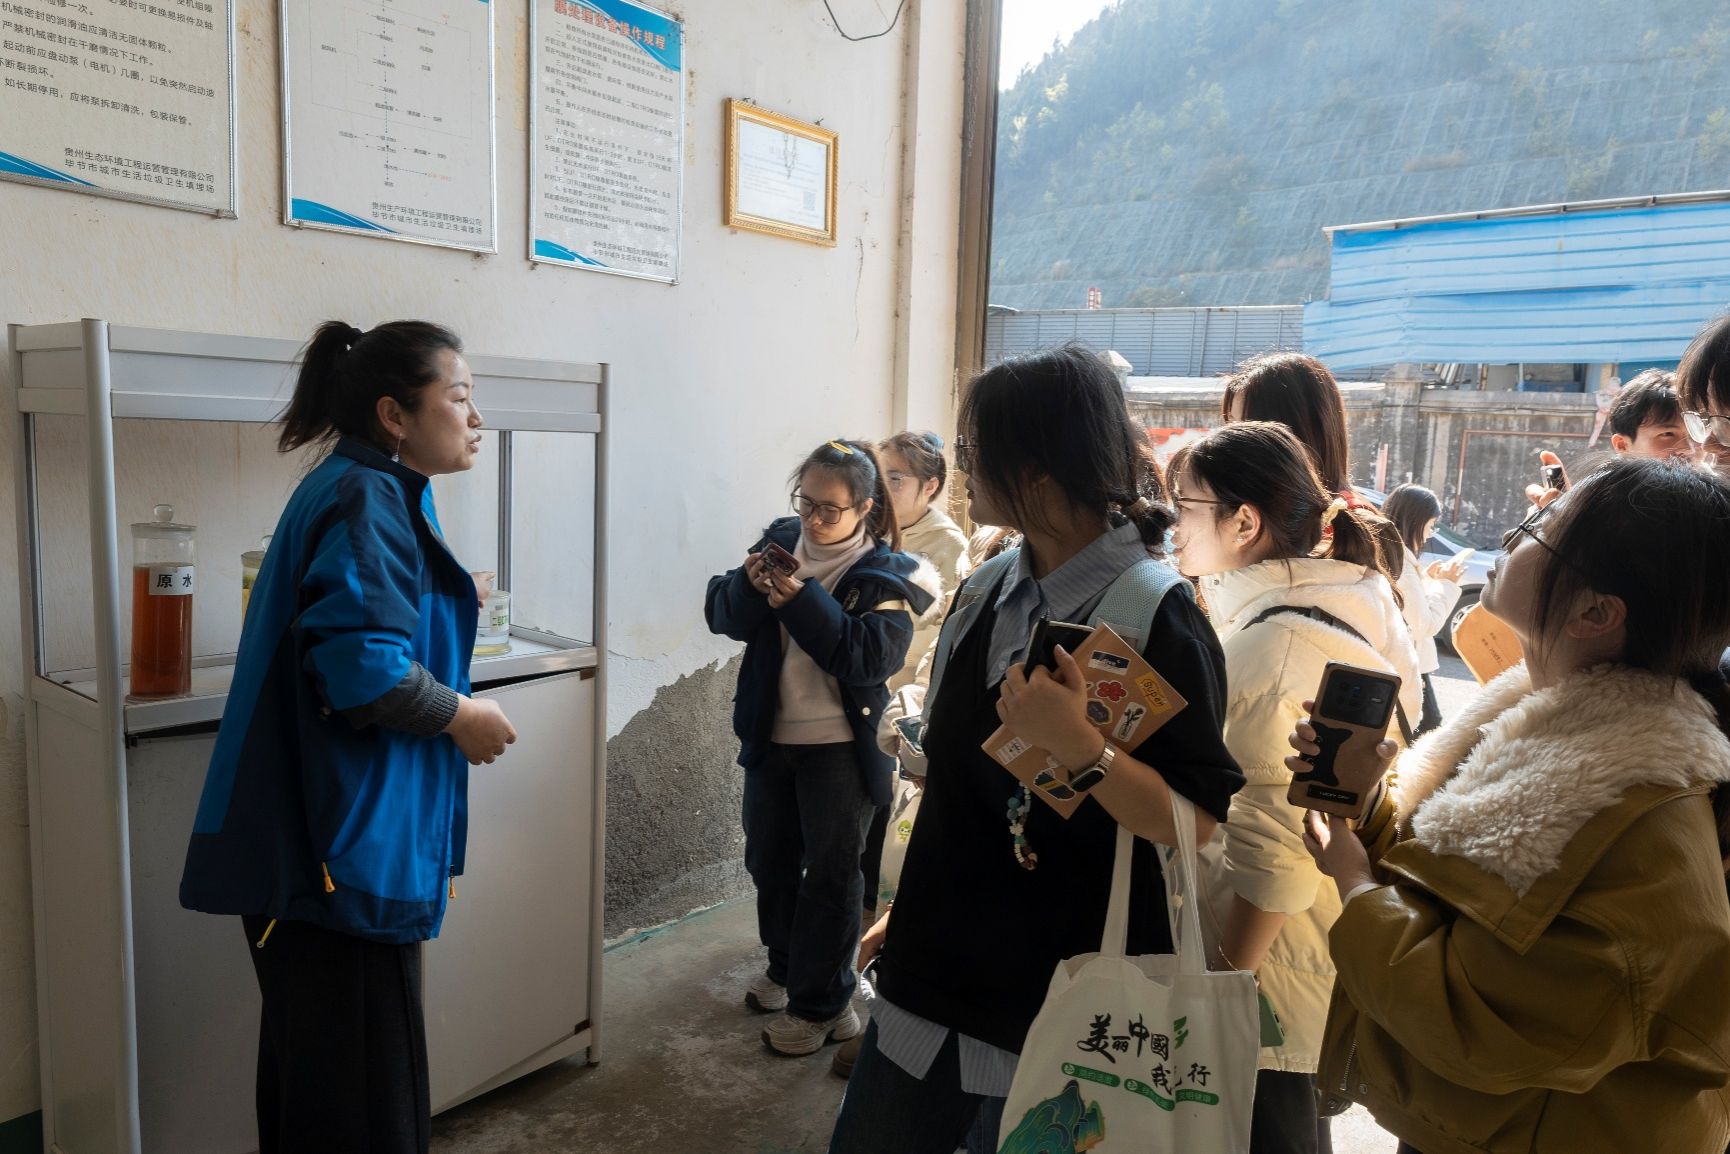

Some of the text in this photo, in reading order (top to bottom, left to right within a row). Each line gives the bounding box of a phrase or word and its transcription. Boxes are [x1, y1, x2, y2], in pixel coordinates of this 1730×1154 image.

[64, 147, 215, 183] 贵州生态环境工程运营管理有限公司
[64, 158, 215, 194] 毕节市城市生活垃圾卫生填埋场
[157, 573, 192, 588] 原水
